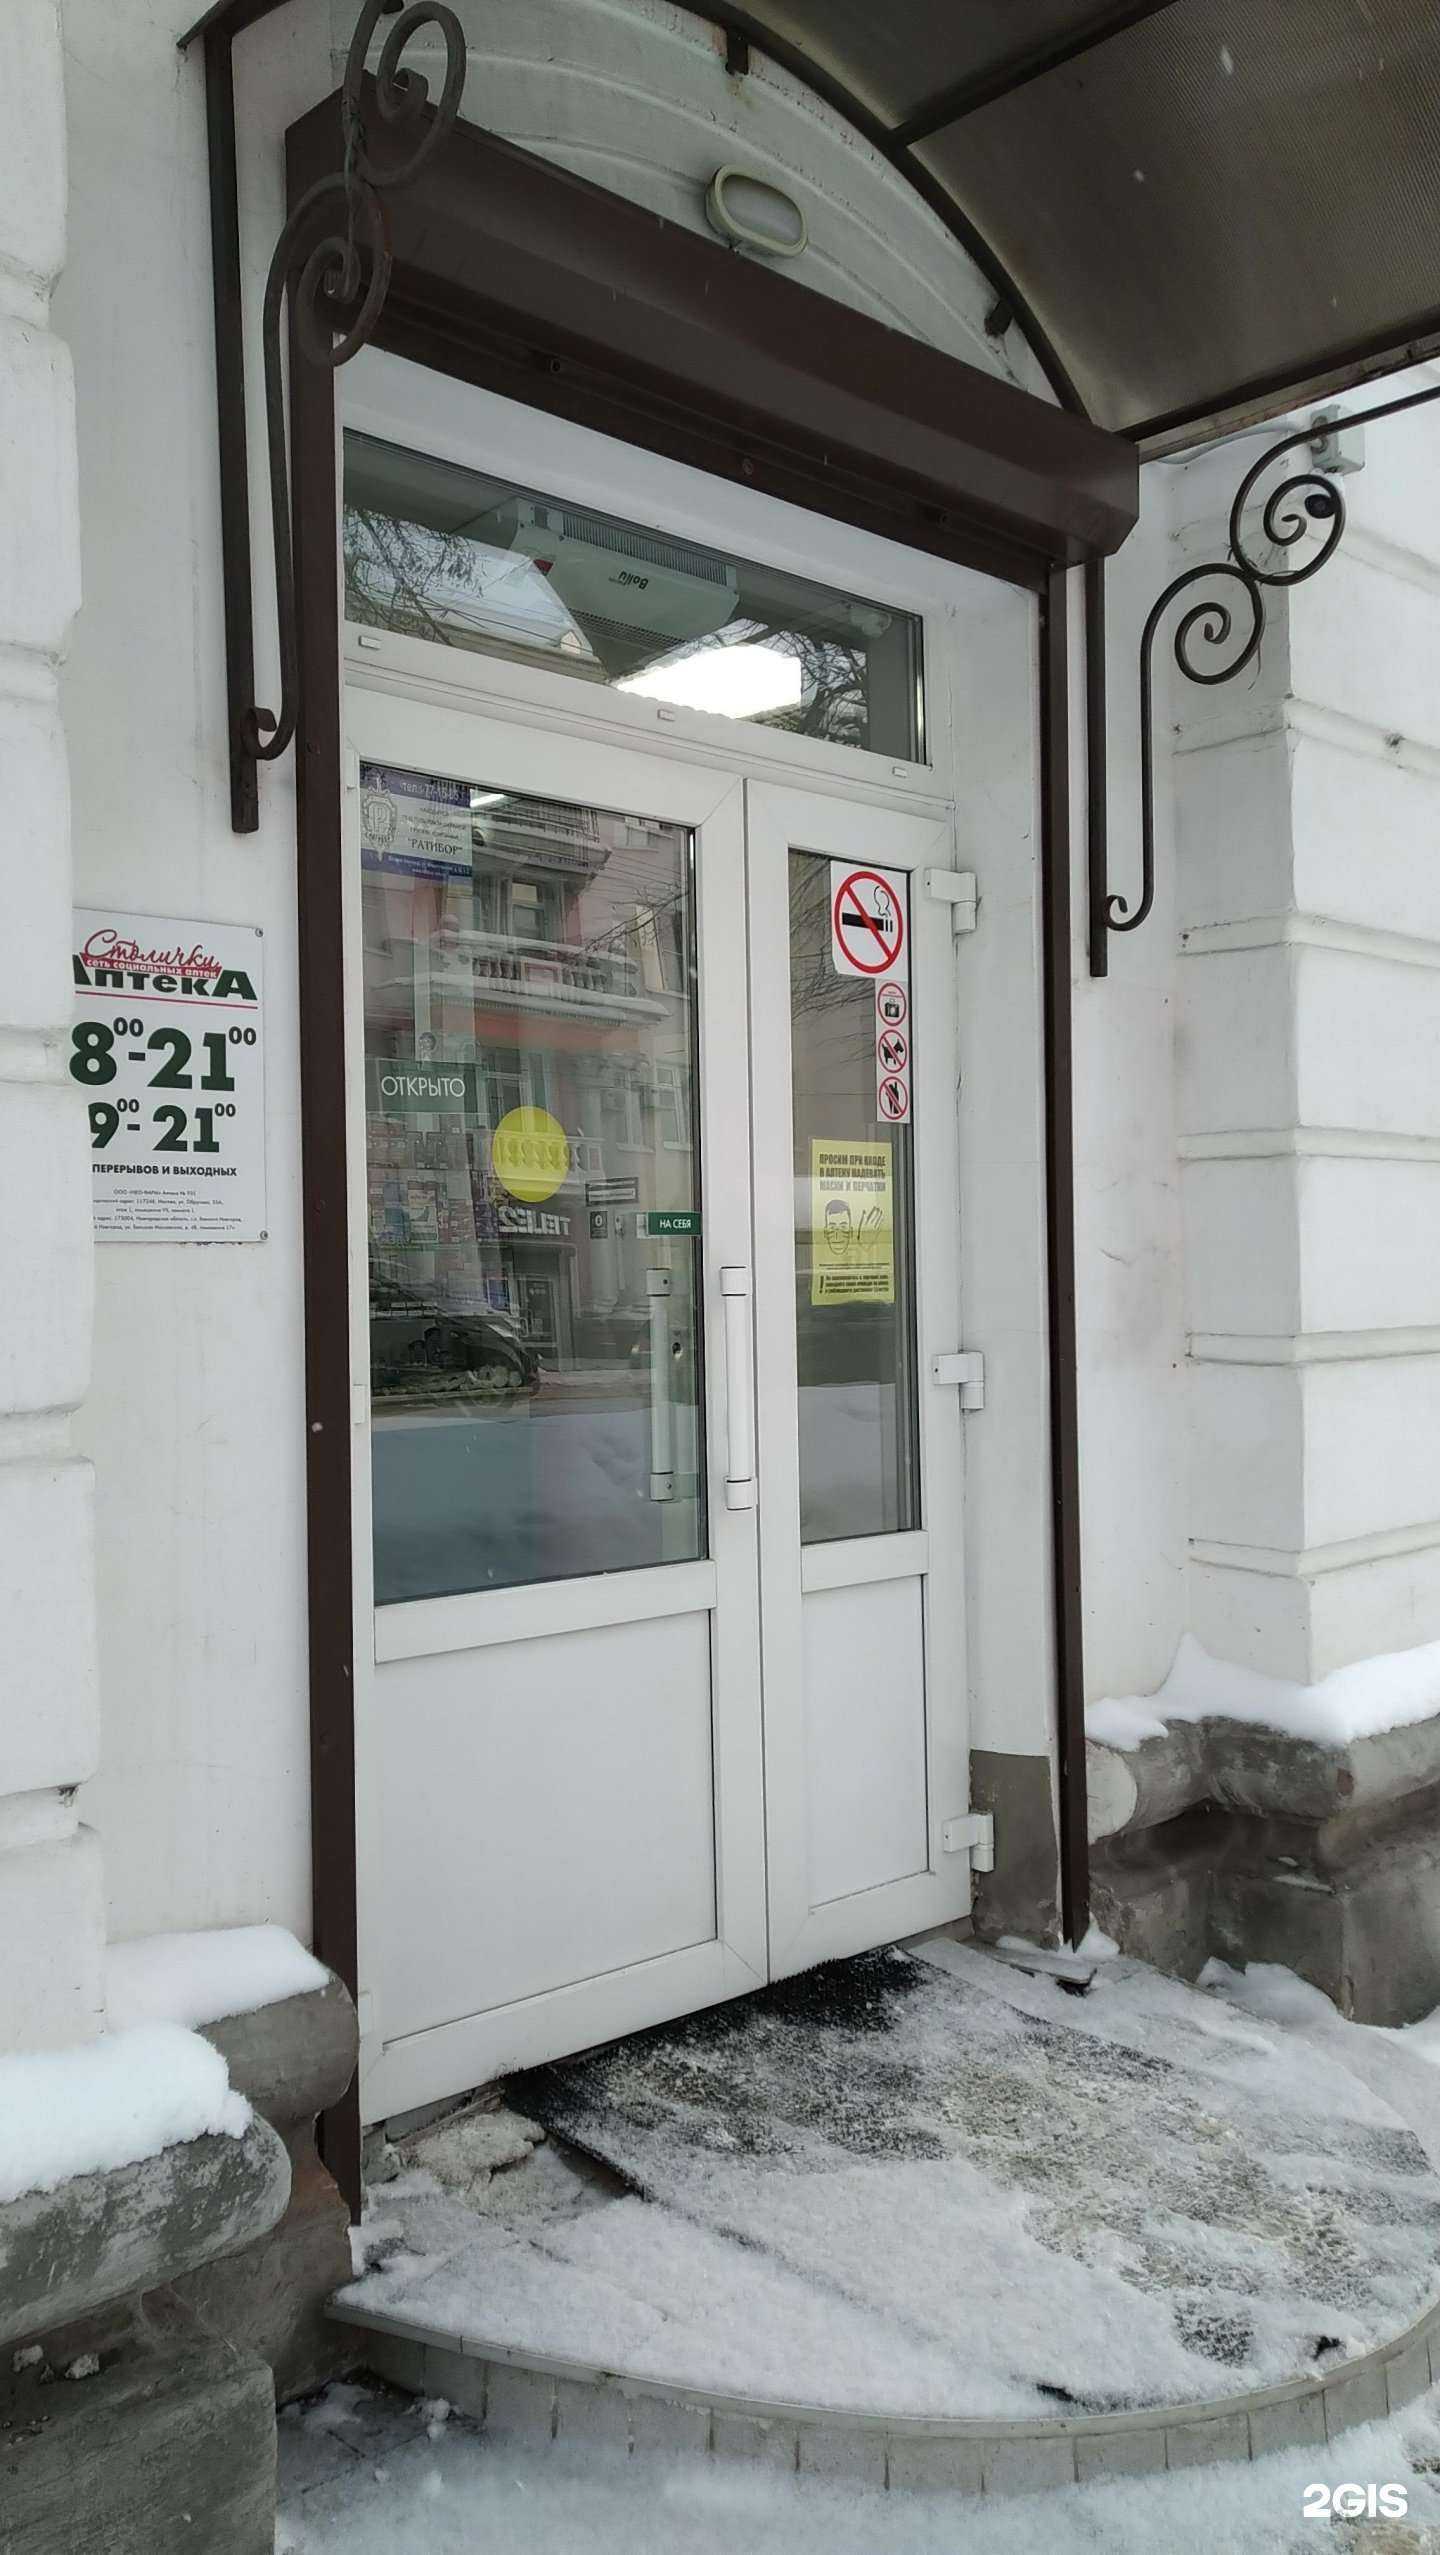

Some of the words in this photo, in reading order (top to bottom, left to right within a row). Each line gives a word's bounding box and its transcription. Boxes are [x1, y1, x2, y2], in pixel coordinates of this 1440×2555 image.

[85, 929, 221, 969] Столички
[86, 958, 111, 968] сеть
[113, 962, 182, 976] социальных
[184, 967, 217, 978] аптек
[381, 1076, 465, 1097] ОТКРЫТО
[819, 1153, 848, 1165] ПРОСИМ
[849, 1155, 863, 1165] ПРИ
[92, 1164, 159, 1175] ПЕРЕРЫВОВ
[162, 1166, 170, 1175] И
[173, 1166, 237, 1177] ВЫХОДНЫХ
[826, 1167, 850, 1178] АПТЕКУ
[660, 1219, 672, 1228] НА
[672, 1219, 691, 1228] СЕБЯ
